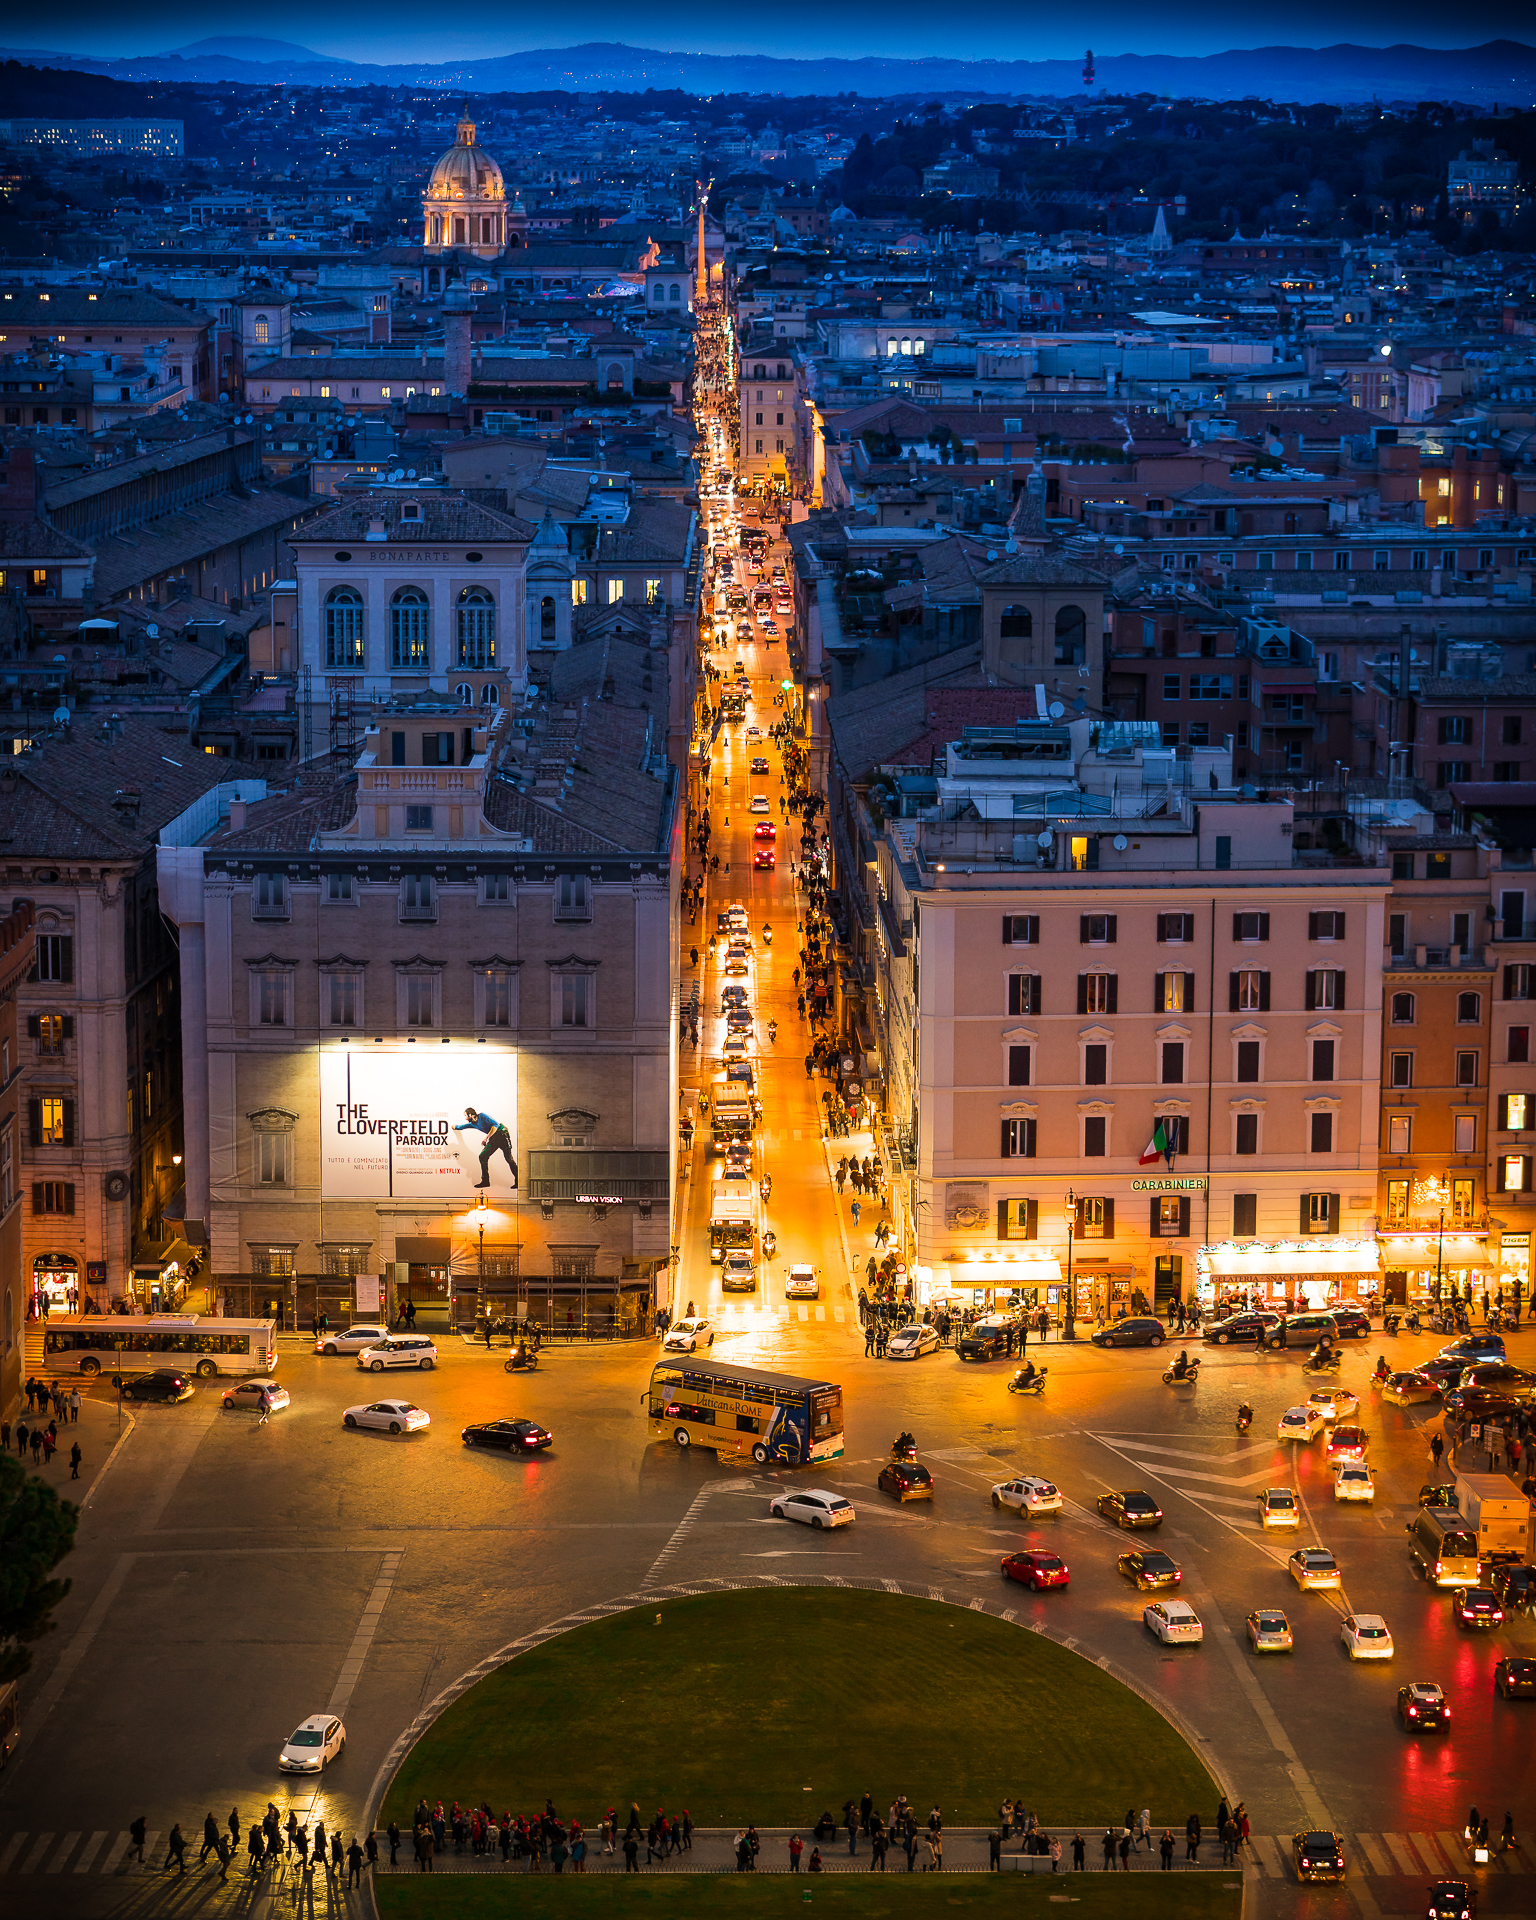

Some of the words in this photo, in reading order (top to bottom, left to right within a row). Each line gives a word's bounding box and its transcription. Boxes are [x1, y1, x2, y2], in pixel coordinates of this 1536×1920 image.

[370, 552, 450, 561] BONAPARTE
[336, 1104, 369, 1119] THE
[337, 1119, 449, 1135] CLOVERFIELD
[396, 1136, 449, 1146] PARADOX
[1132, 1179, 1206, 1190] CARABINIERI
[1211, 1275, 1258, 1283] GELATERIA
[1266, 1274, 1295, 1282] SNACK
[696, 1393, 729, 1411] Vatican
[735, 1401, 762, 1417] ROME
